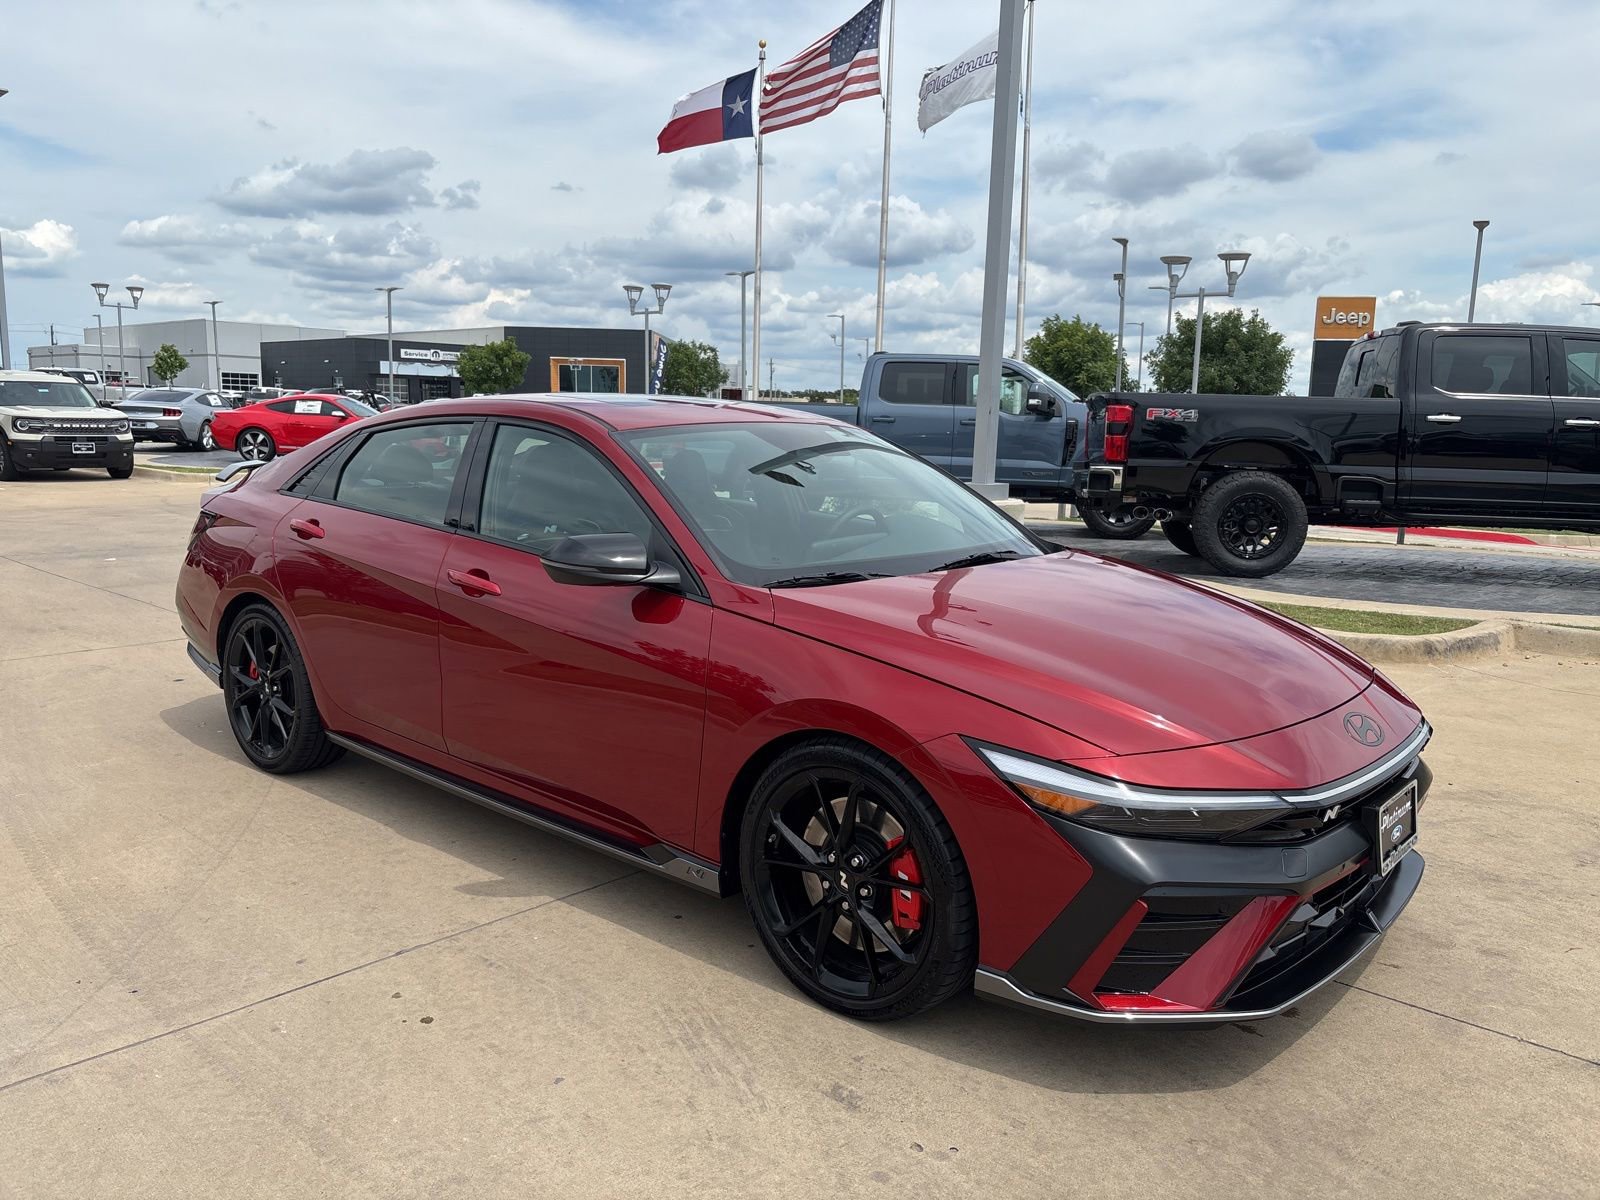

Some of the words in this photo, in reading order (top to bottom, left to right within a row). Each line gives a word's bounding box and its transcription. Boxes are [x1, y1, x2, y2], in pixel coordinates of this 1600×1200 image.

[1322, 308, 1371, 328] Jeep
[404, 350, 428, 358] Service
[1146, 407, 1198, 421] FX4
[1323, 805, 1341, 823] N
[1381, 800, 1412, 832] Platinum
